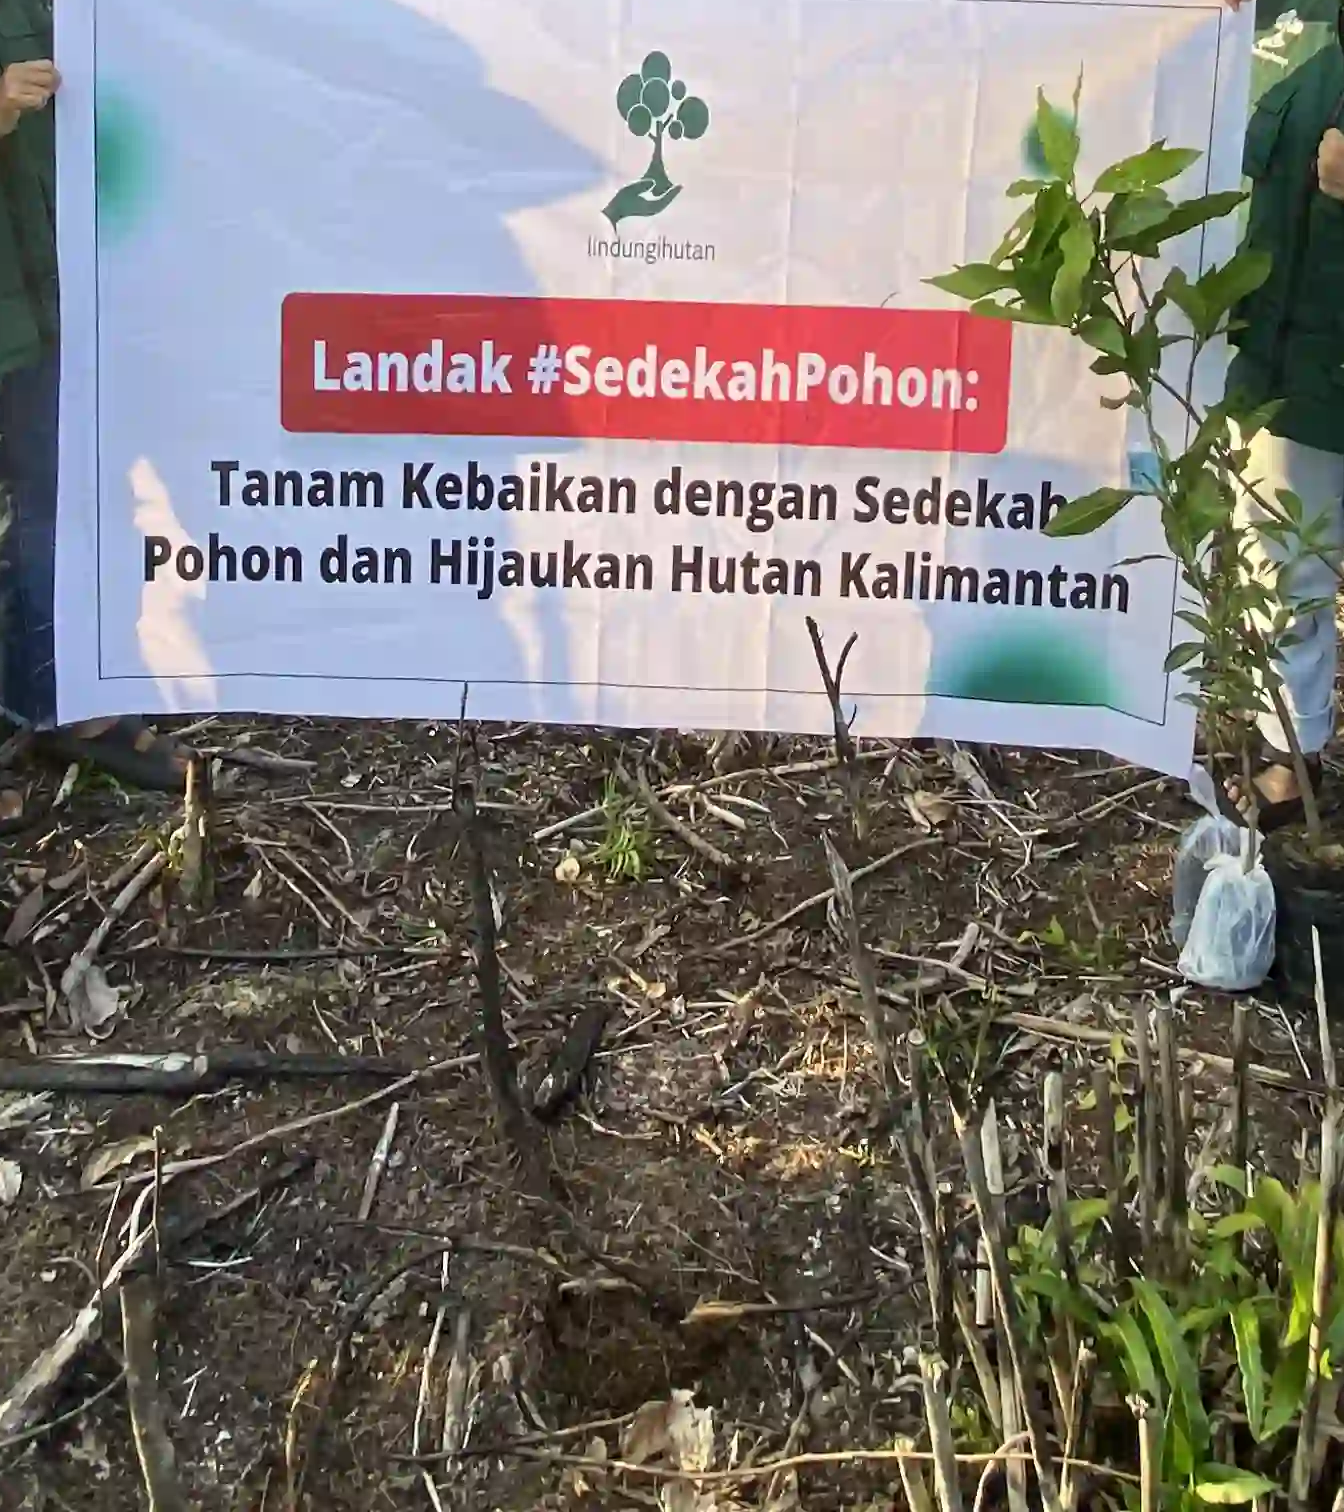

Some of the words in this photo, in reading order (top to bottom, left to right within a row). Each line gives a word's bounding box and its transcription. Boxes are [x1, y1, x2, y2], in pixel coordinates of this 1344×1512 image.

[587, 235, 716, 265] lindungihutan
[313, 338, 513, 394] Landak
[526, 344, 979, 411] #SedekahPohon:
[210, 460, 384, 508] Tanam
[402, 460, 636, 514] Kebaikan
[654, 466, 837, 533] dengan
[144, 532, 303, 583] Pohon
[319, 534, 412, 584] dan
[430, 535, 653, 600] Hijaukan
[671, 545, 821, 597] Hutan
[838, 550, 1130, 614] Kalimantan
